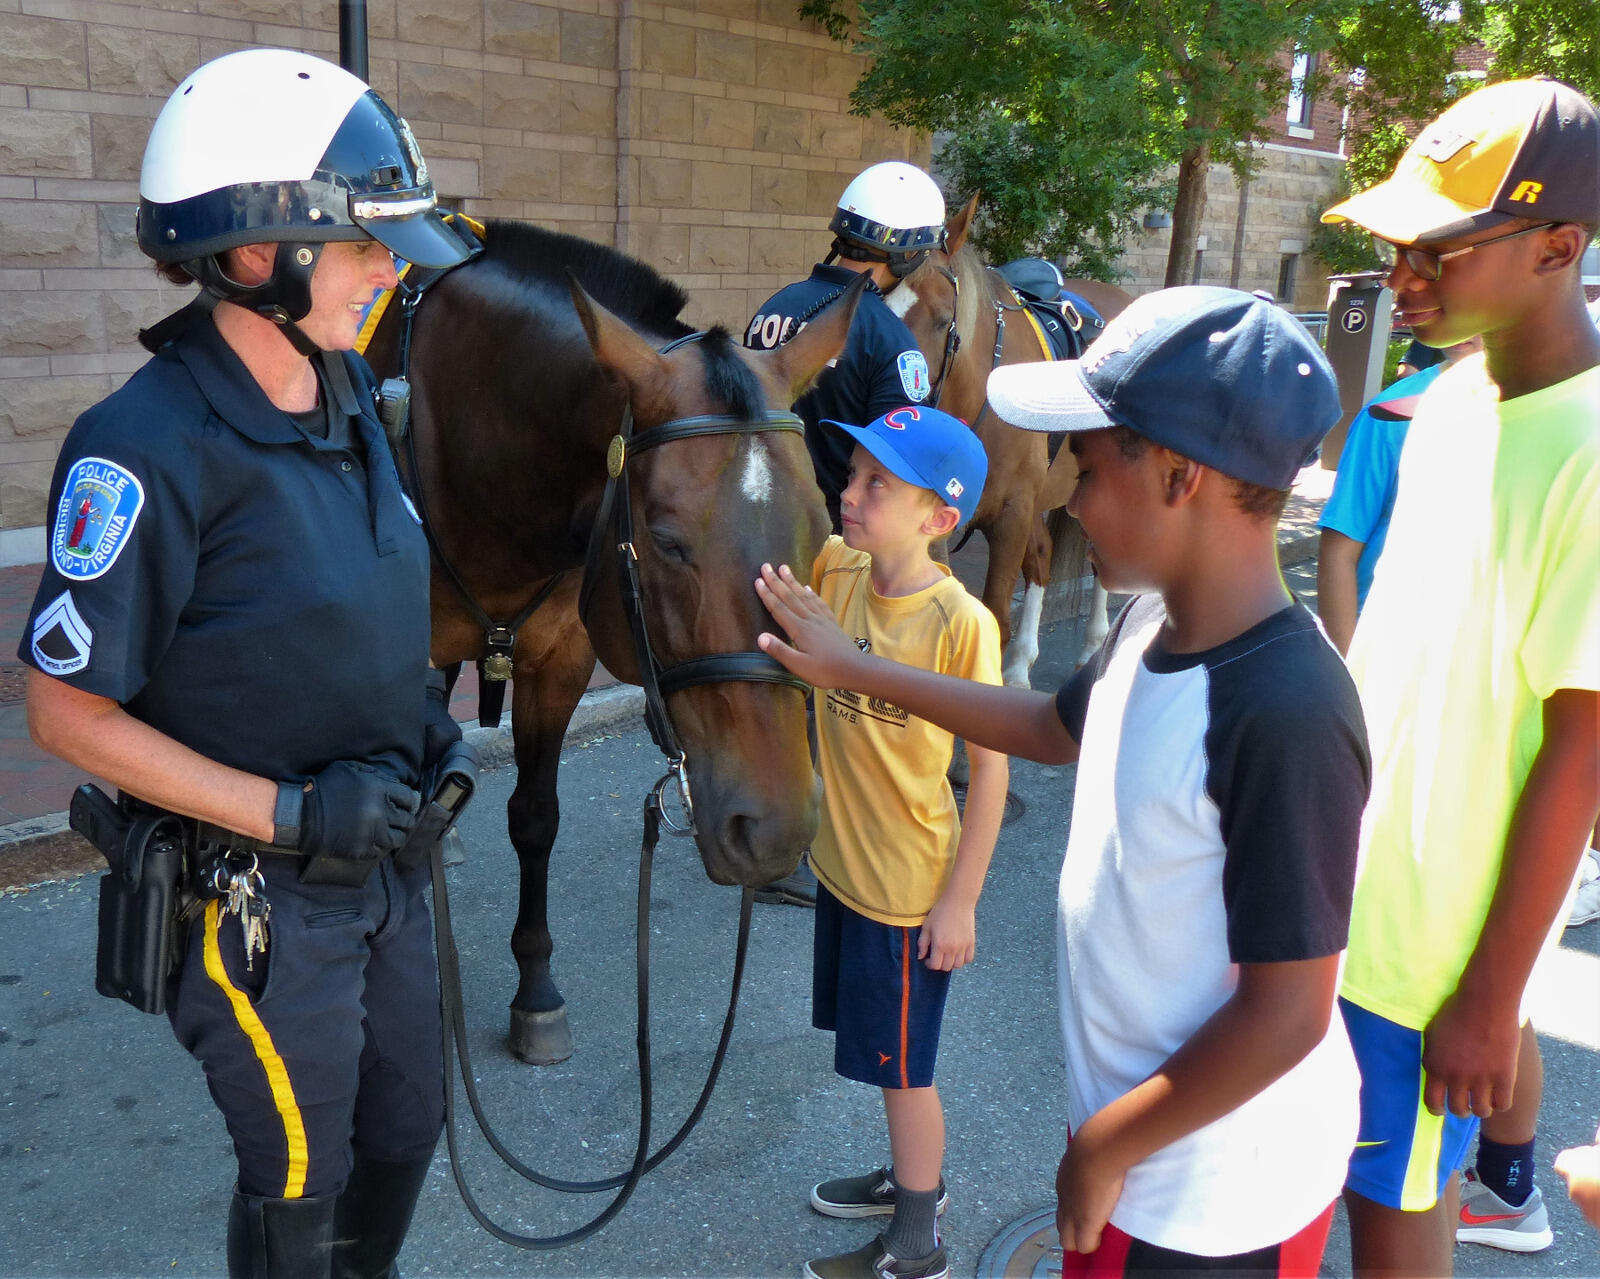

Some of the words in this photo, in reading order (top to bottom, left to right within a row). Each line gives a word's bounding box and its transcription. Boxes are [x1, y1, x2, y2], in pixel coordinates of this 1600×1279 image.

[1508, 181, 1543, 204] R
[1347, 312, 1362, 328] P
[884, 406, 920, 430] C
[78, 464, 129, 493] POLICE
[826, 702, 857, 724] RAMS
